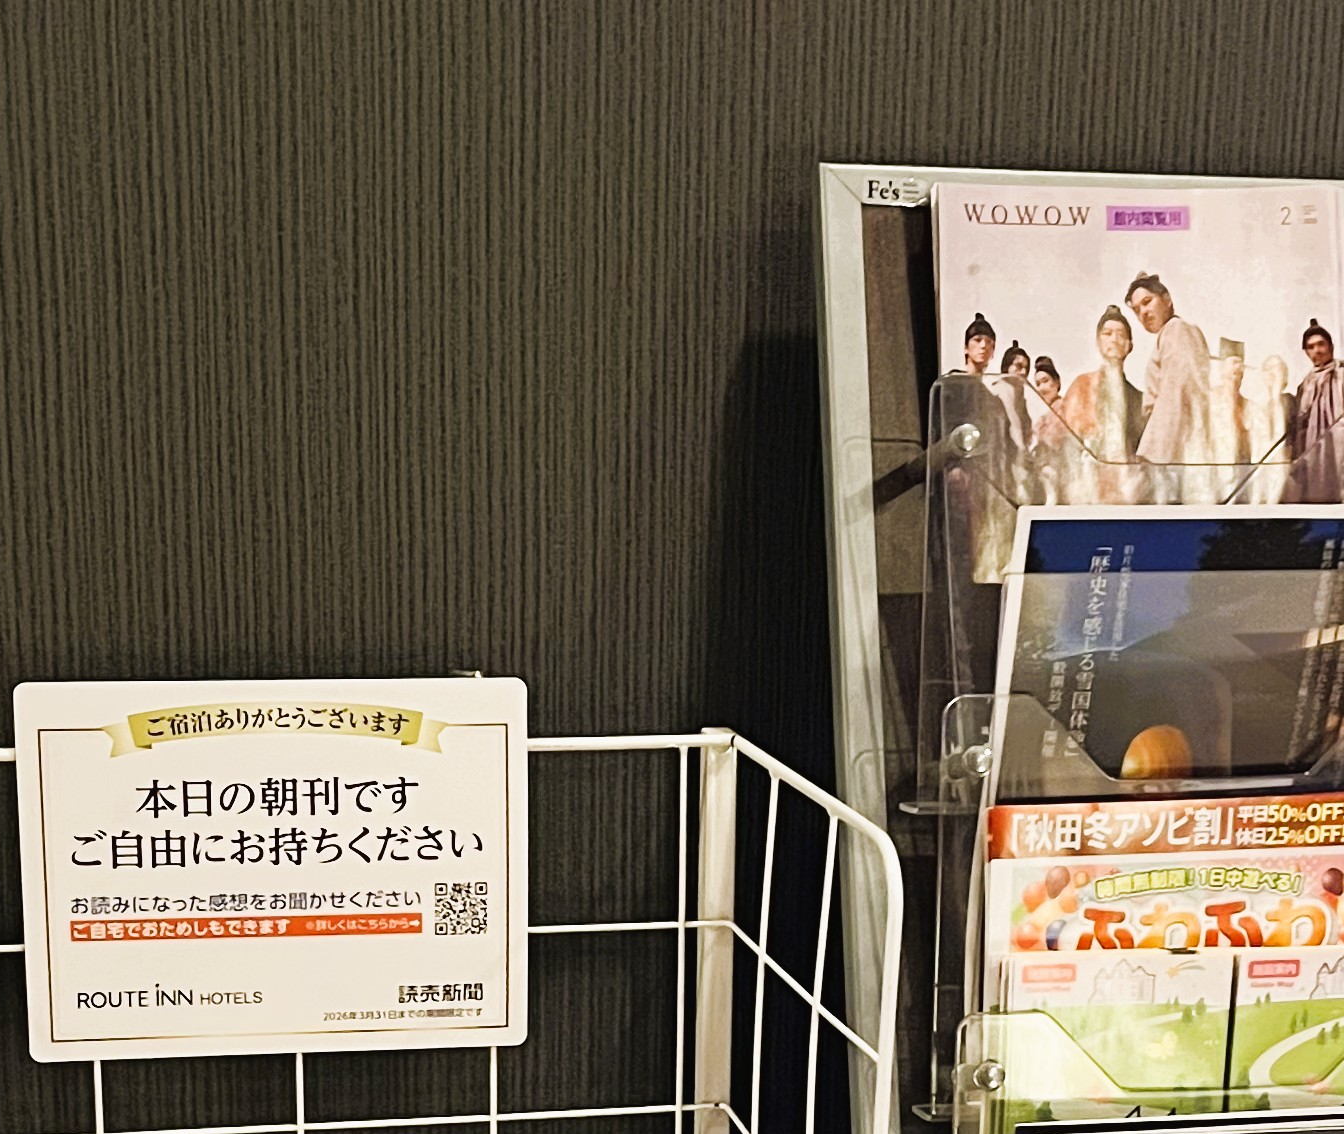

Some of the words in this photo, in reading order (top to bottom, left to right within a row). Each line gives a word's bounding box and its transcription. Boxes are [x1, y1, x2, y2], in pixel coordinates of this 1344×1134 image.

[964, 202, 1092, 226] WOWOW
[1280, 206, 1292, 226] 2
[145, 706, 411, 738] ご宿泊ありがとうございます
[136, 775, 420, 819] 本日の朝刊です
[1011, 805, 1235, 853] 「秋田冬アソビ割」
[70, 826, 484, 870] ご自由にお持ちください
[70, 889, 421, 915] お読みになった感想をお聞かせください
[72, 918, 290, 939] ご自宅でおためしもできます
[1077, 898, 1327, 951] ふわふわ
[77, 988, 149, 1010] ROUTE
[201, 989, 263, 1006] HOTELS
[398, 982, 484, 1004] 読売新聞
